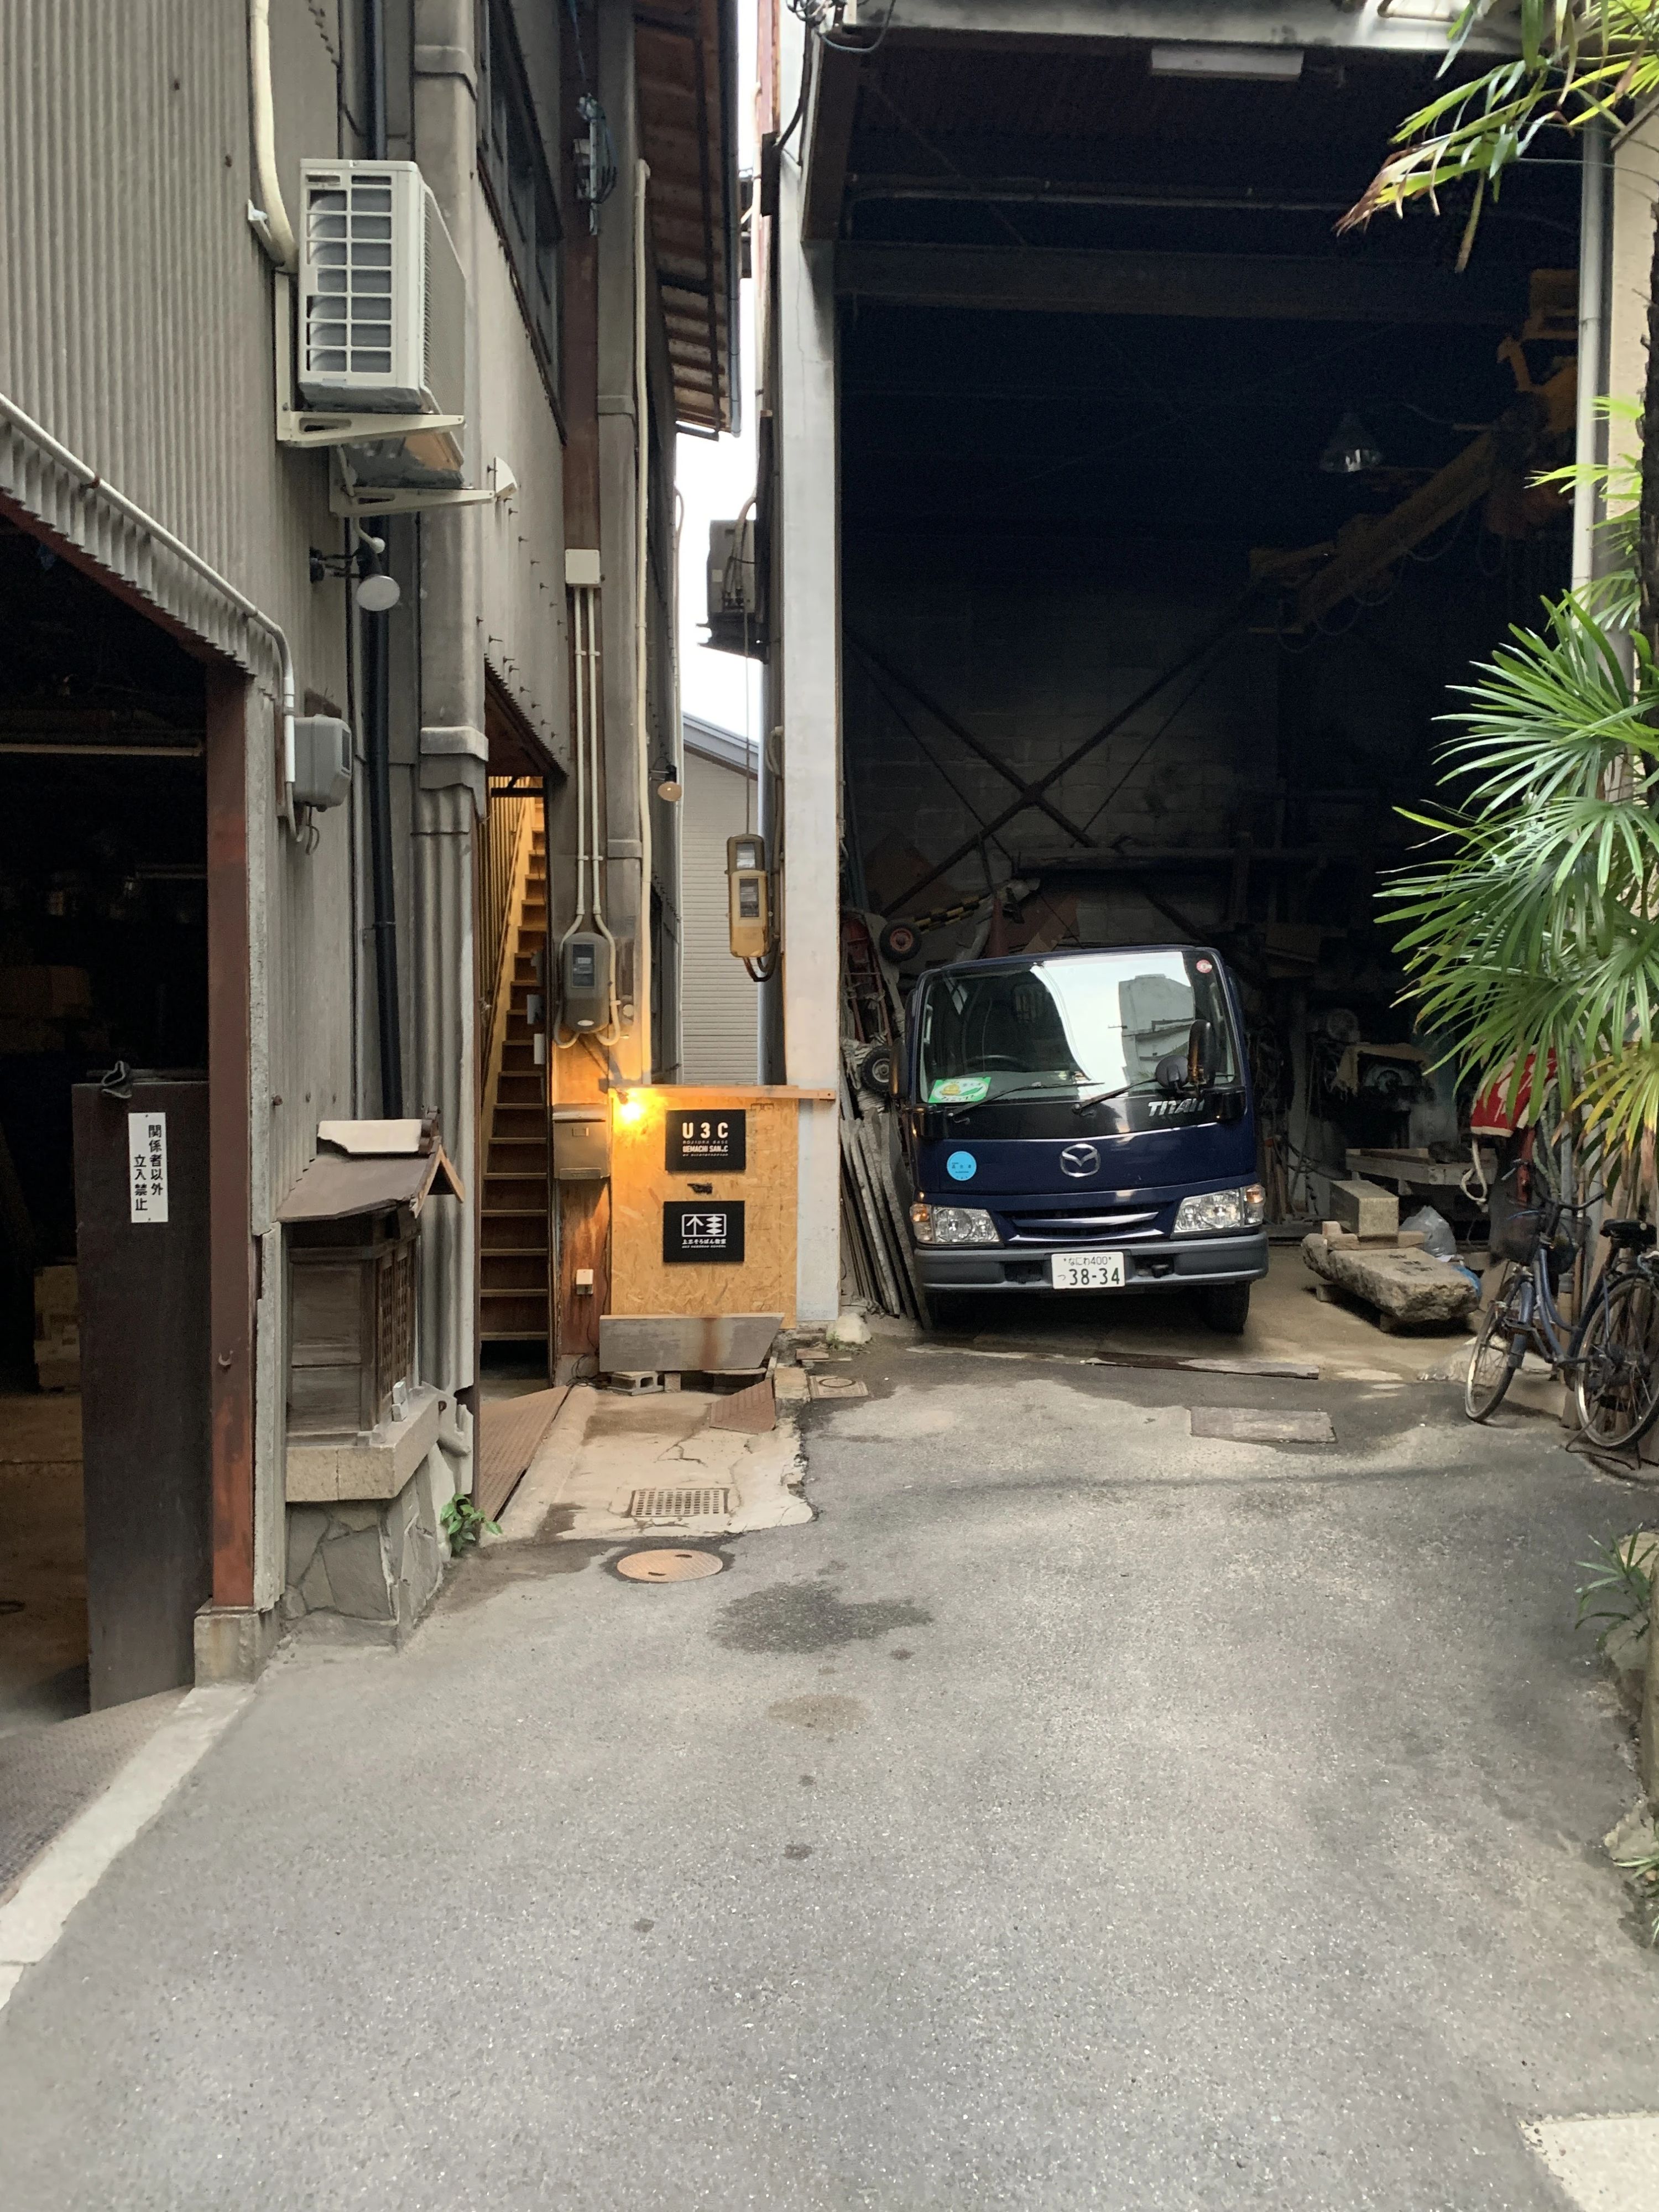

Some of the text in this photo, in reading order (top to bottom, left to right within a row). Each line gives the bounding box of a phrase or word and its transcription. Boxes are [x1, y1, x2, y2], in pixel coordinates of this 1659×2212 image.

[134, 1154, 148, 1211] 立入禁止
[148, 1124, 164, 1196] 関係者以外
[1068, 1267, 1120, 1286] 38-34
